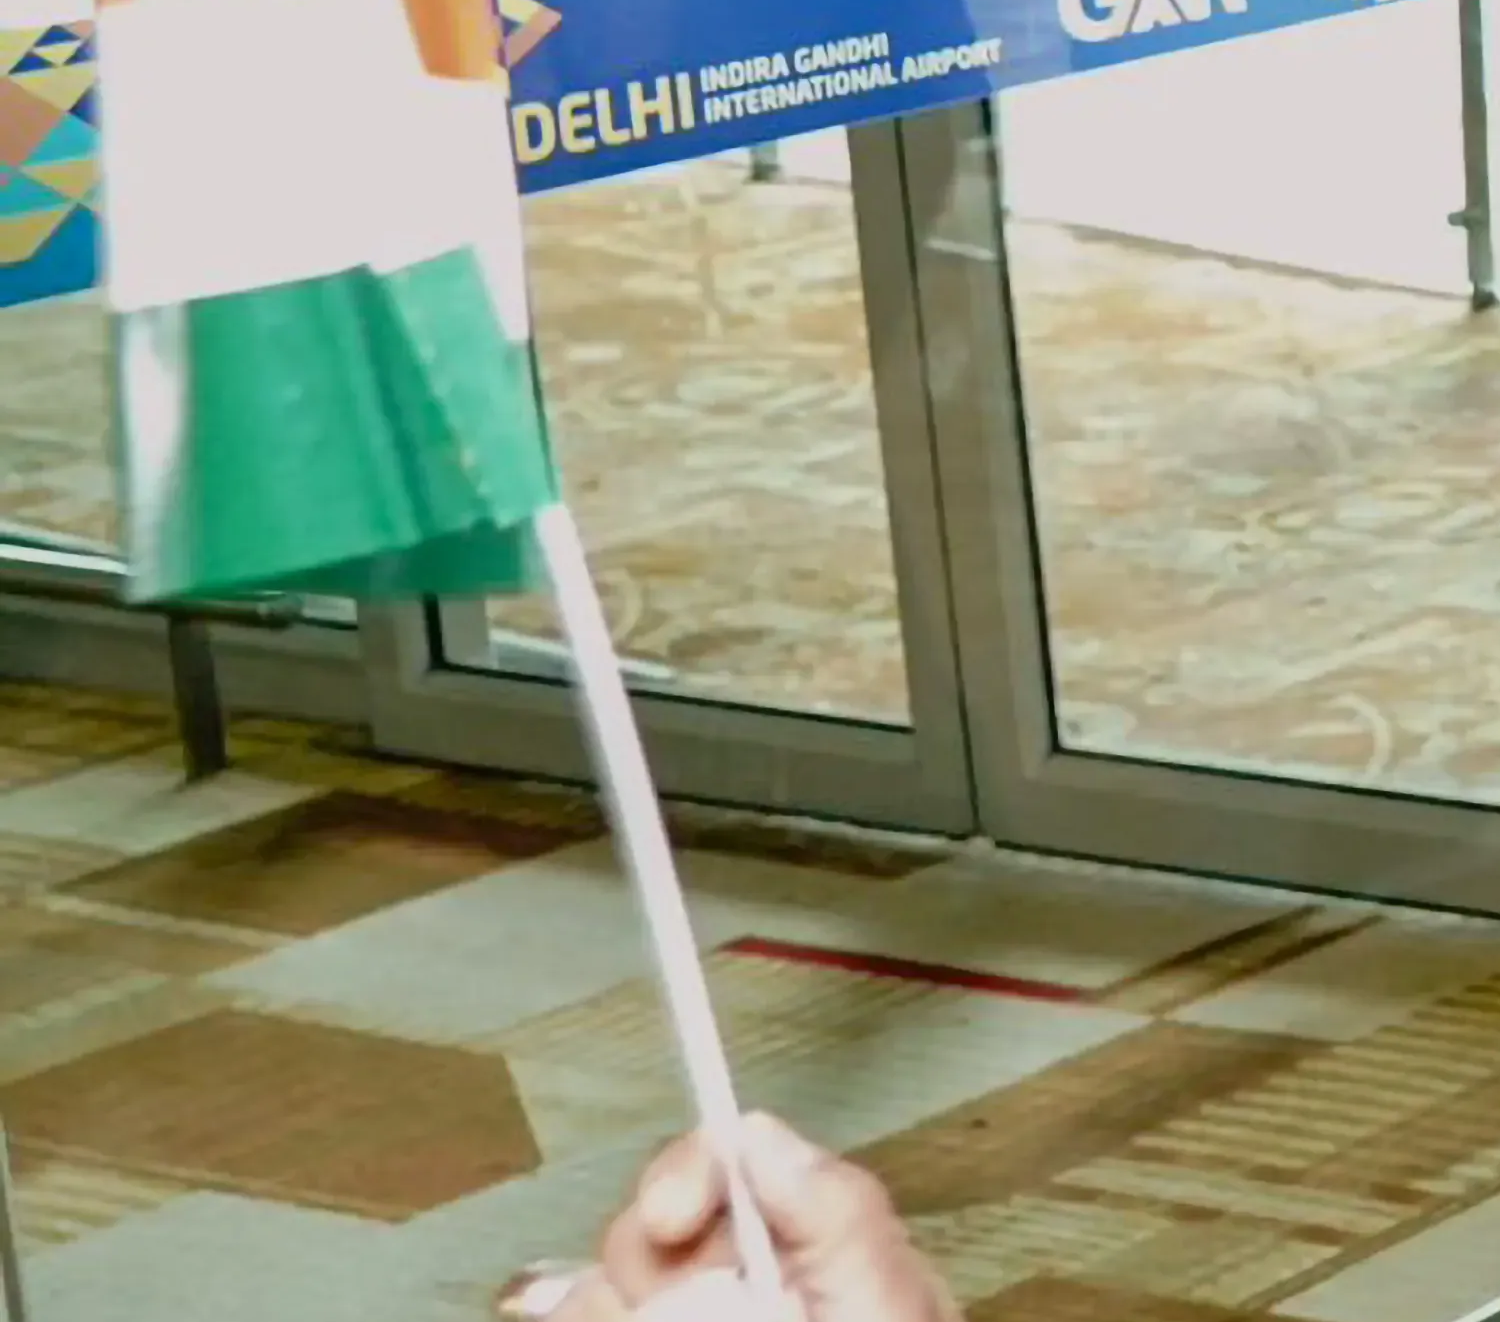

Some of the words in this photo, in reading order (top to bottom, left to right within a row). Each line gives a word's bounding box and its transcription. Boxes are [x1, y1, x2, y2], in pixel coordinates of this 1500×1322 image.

[701, 50, 789, 92] INDIRA
[794, 33, 890, 73] GANDHI
[704, 63, 898, 124] INTERNATIONAL
[902, 38, 1002, 81] AIRPORT
[512, 71, 695, 164] DELHI
